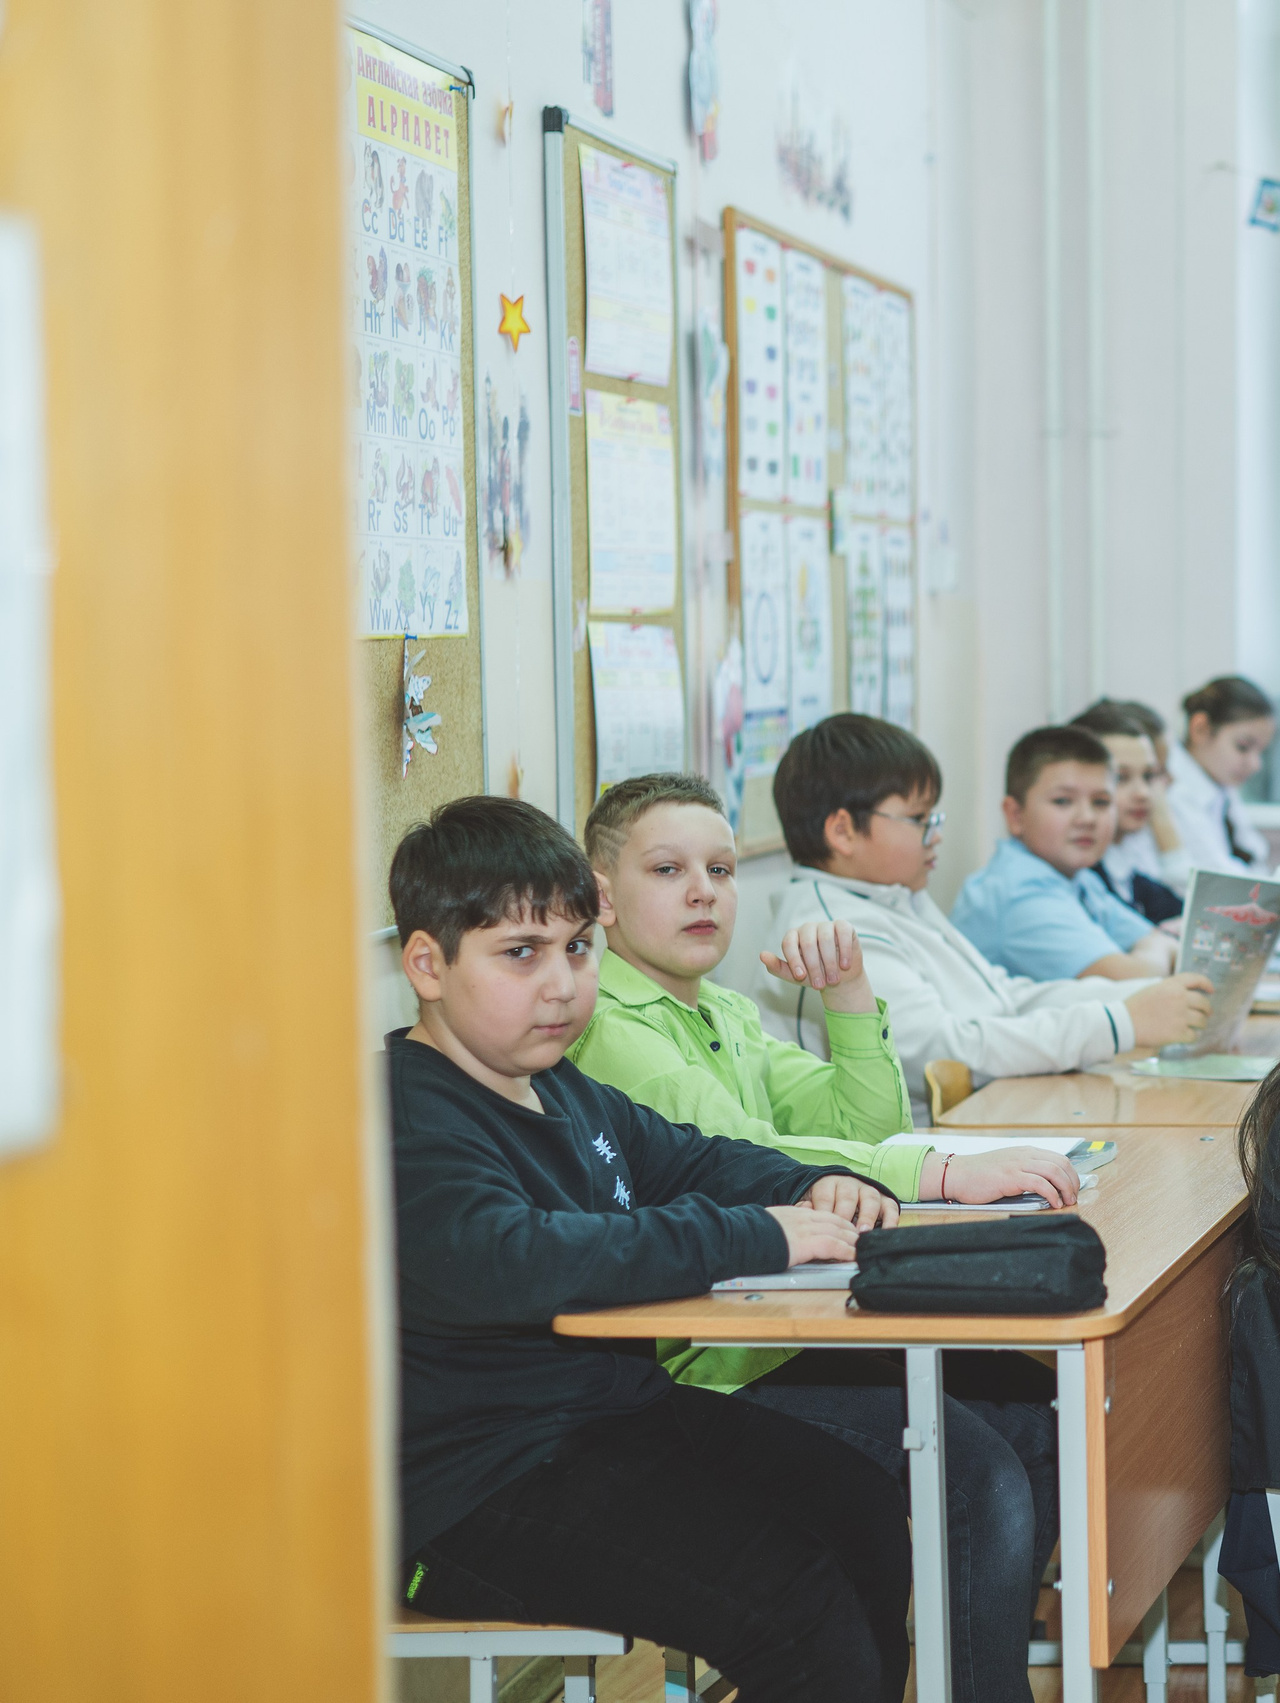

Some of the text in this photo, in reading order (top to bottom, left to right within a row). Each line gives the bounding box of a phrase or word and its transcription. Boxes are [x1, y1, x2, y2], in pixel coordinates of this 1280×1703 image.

[367, 95, 449, 159] ALPHABET
[361, 199, 379, 235] Cc
[389, 207, 405, 243] Dd
[413, 216, 428, 250] Ee
[438, 225, 449, 258] Ff
[363, 299, 381, 335] Hh
[439, 319, 455, 352] Kk
[366, 399, 387, 434] Mm
[392, 404, 408, 438] Nn
[418, 407, 436, 441] Oo
[442, 404, 456, 445] Pp
[367, 498, 381, 532] Rr
[393, 499, 409, 534] Ss
[418, 503, 431, 536] Tt
[443, 505, 458, 537] Uu
[369, 598, 392, 631] Ww
[394, 598, 411, 631] Xx
[419, 590, 436, 630] Yy
[444, 600, 460, 630] Zz
